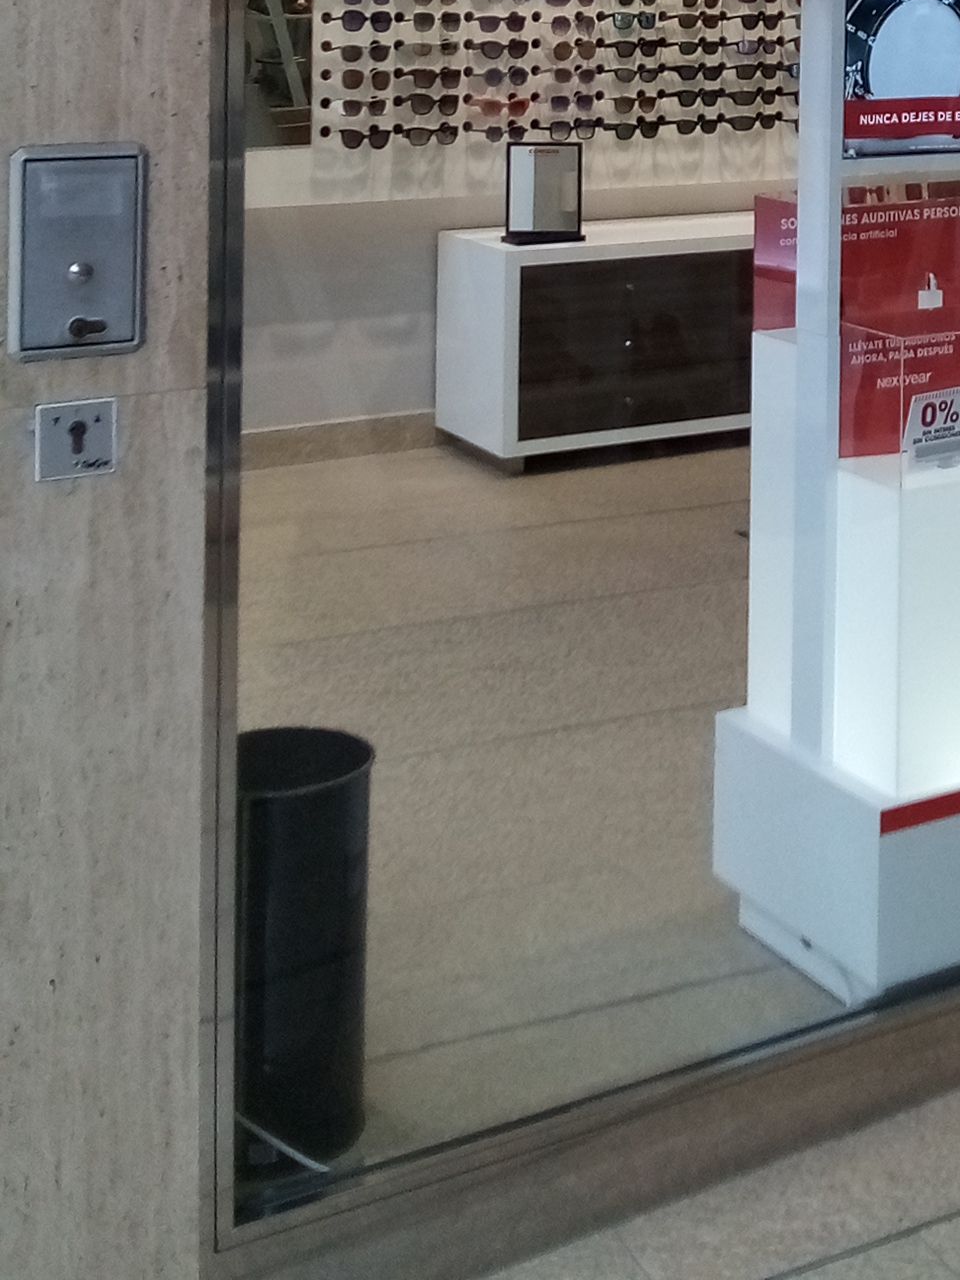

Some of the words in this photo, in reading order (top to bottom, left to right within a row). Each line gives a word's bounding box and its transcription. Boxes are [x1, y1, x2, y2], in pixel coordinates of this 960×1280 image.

[860, 113, 899, 125] NUNCA
[902, 111, 935, 123] DEJES
[938, 110, 952, 121] DE
[861, 210, 921, 225] AUDITIVAS
[860, 228, 897, 240] artificial
[917, 344, 954, 357] DESPUÉS
[921, 398, 959, 428] 0%
